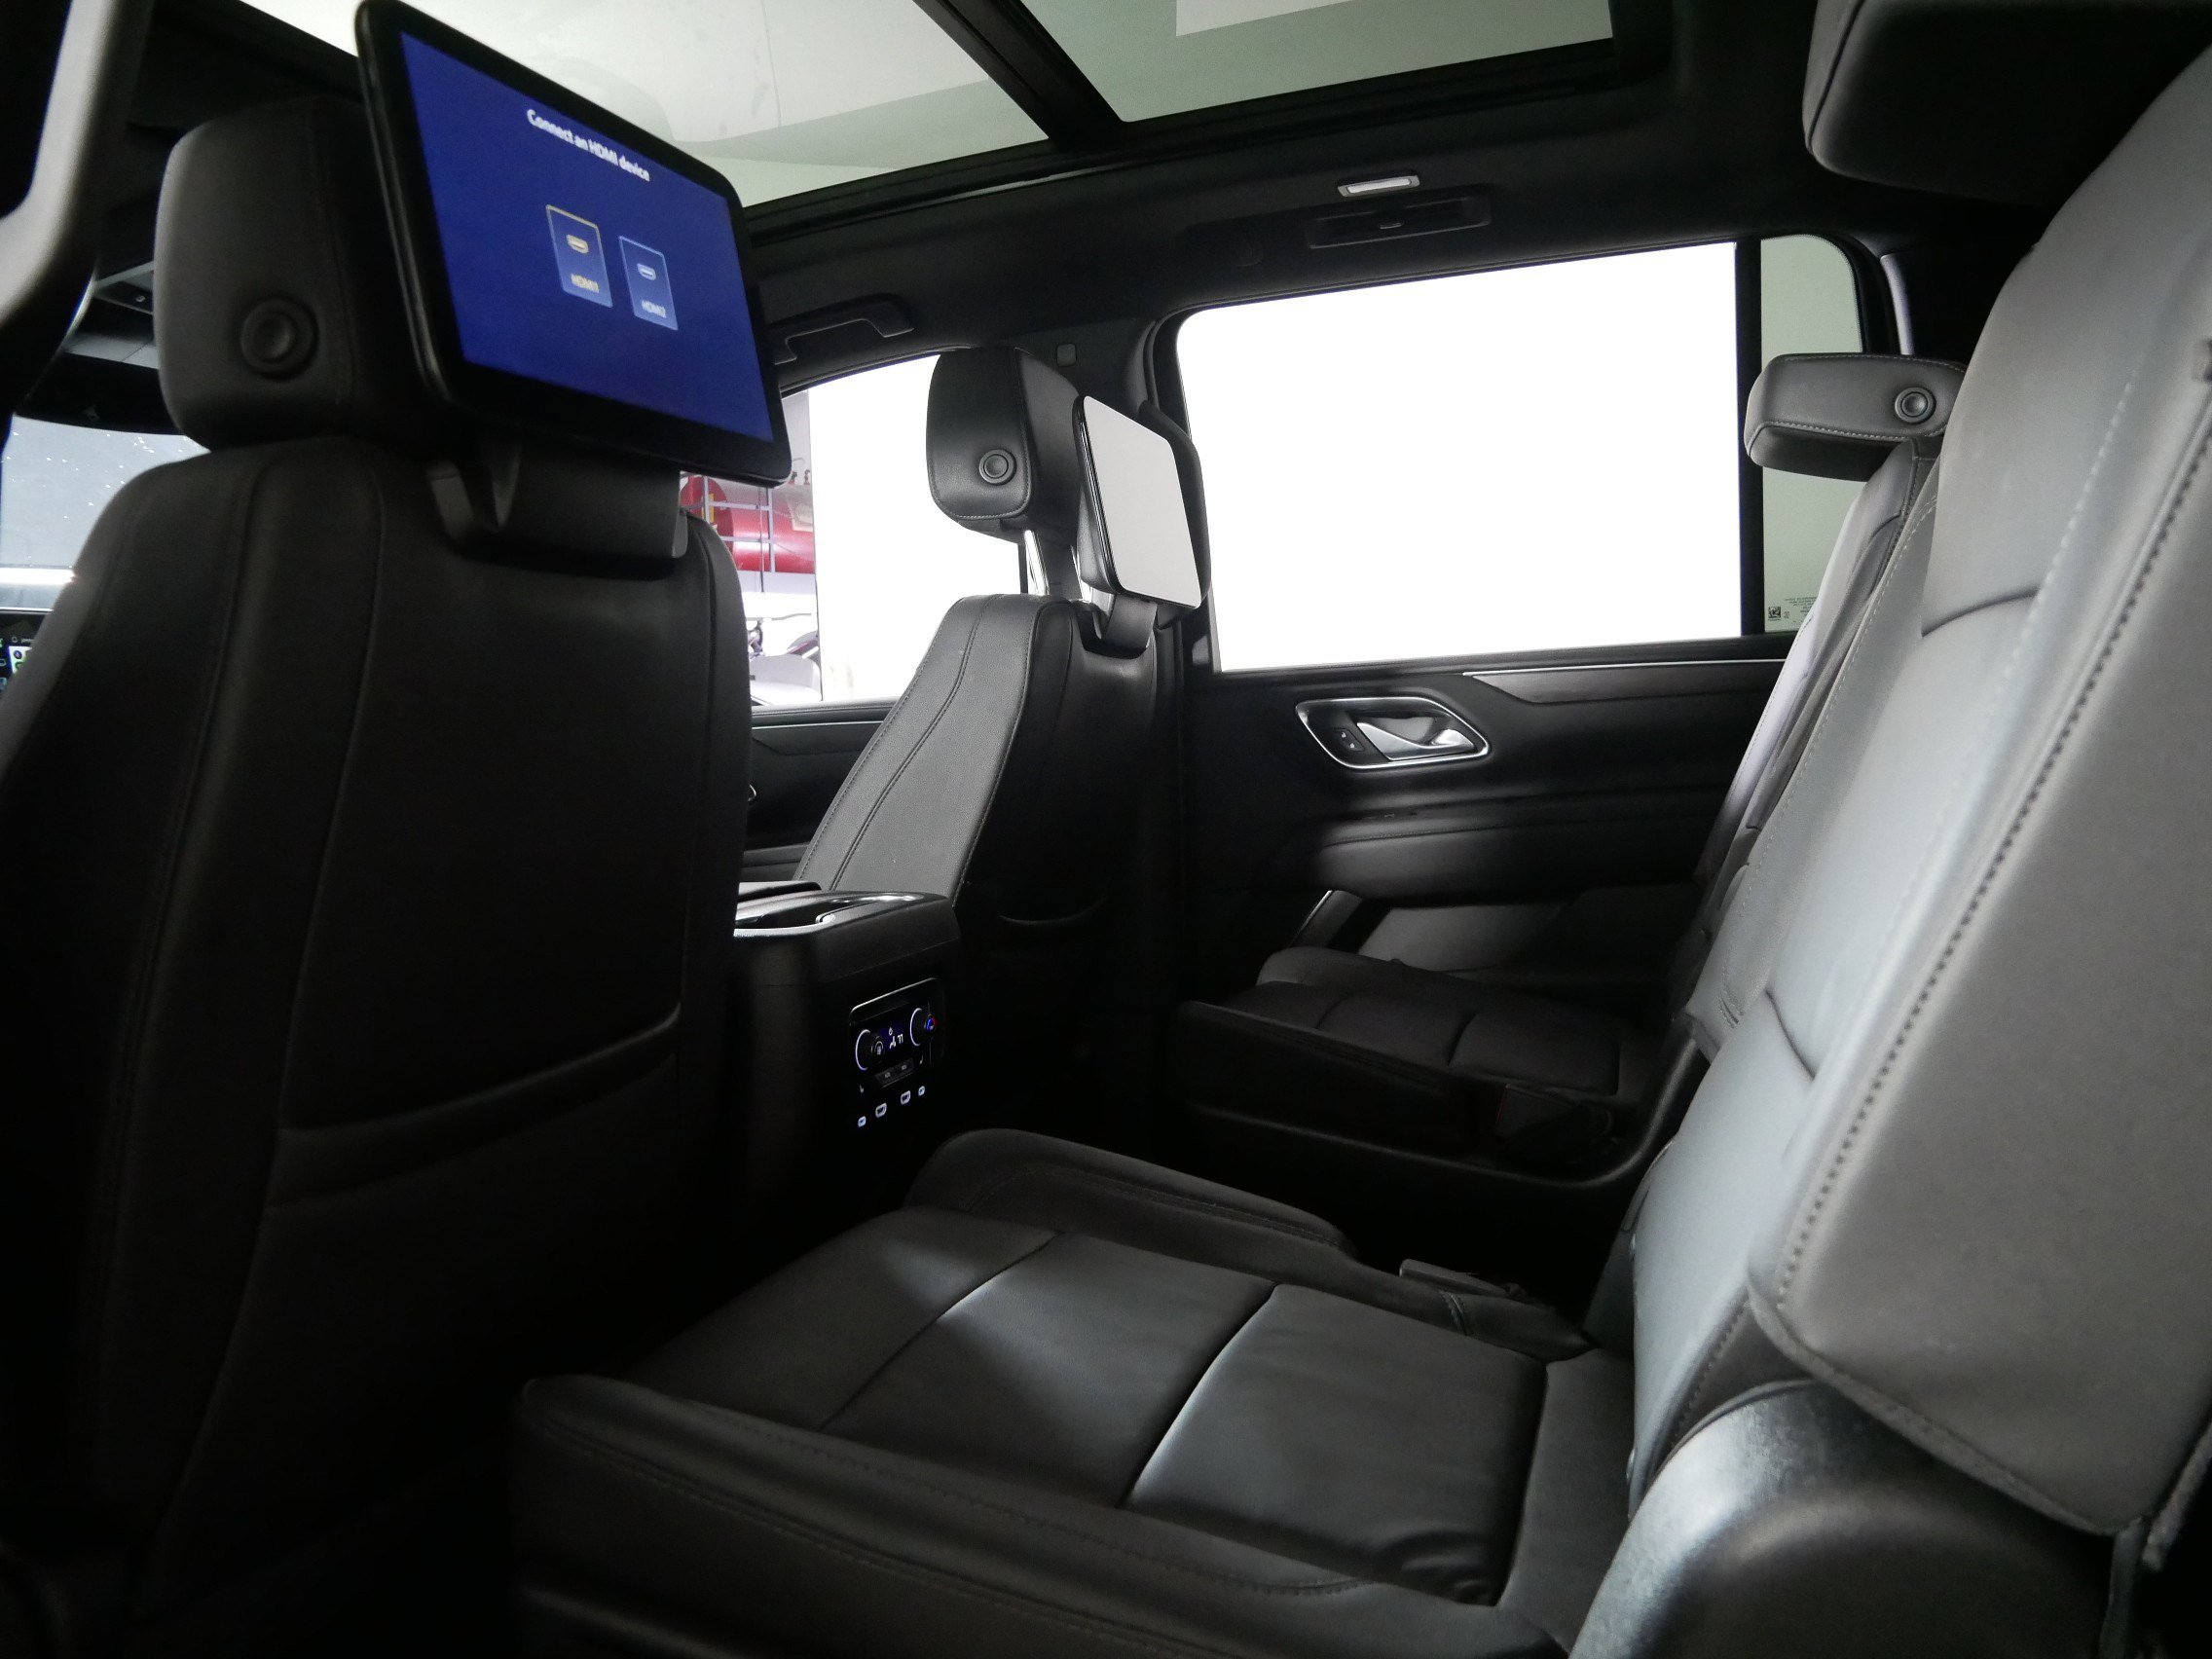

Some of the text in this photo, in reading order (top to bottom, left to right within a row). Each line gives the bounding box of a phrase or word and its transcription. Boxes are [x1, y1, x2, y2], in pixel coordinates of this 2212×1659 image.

[527, 109, 649, 182] Connect an HDMI device
